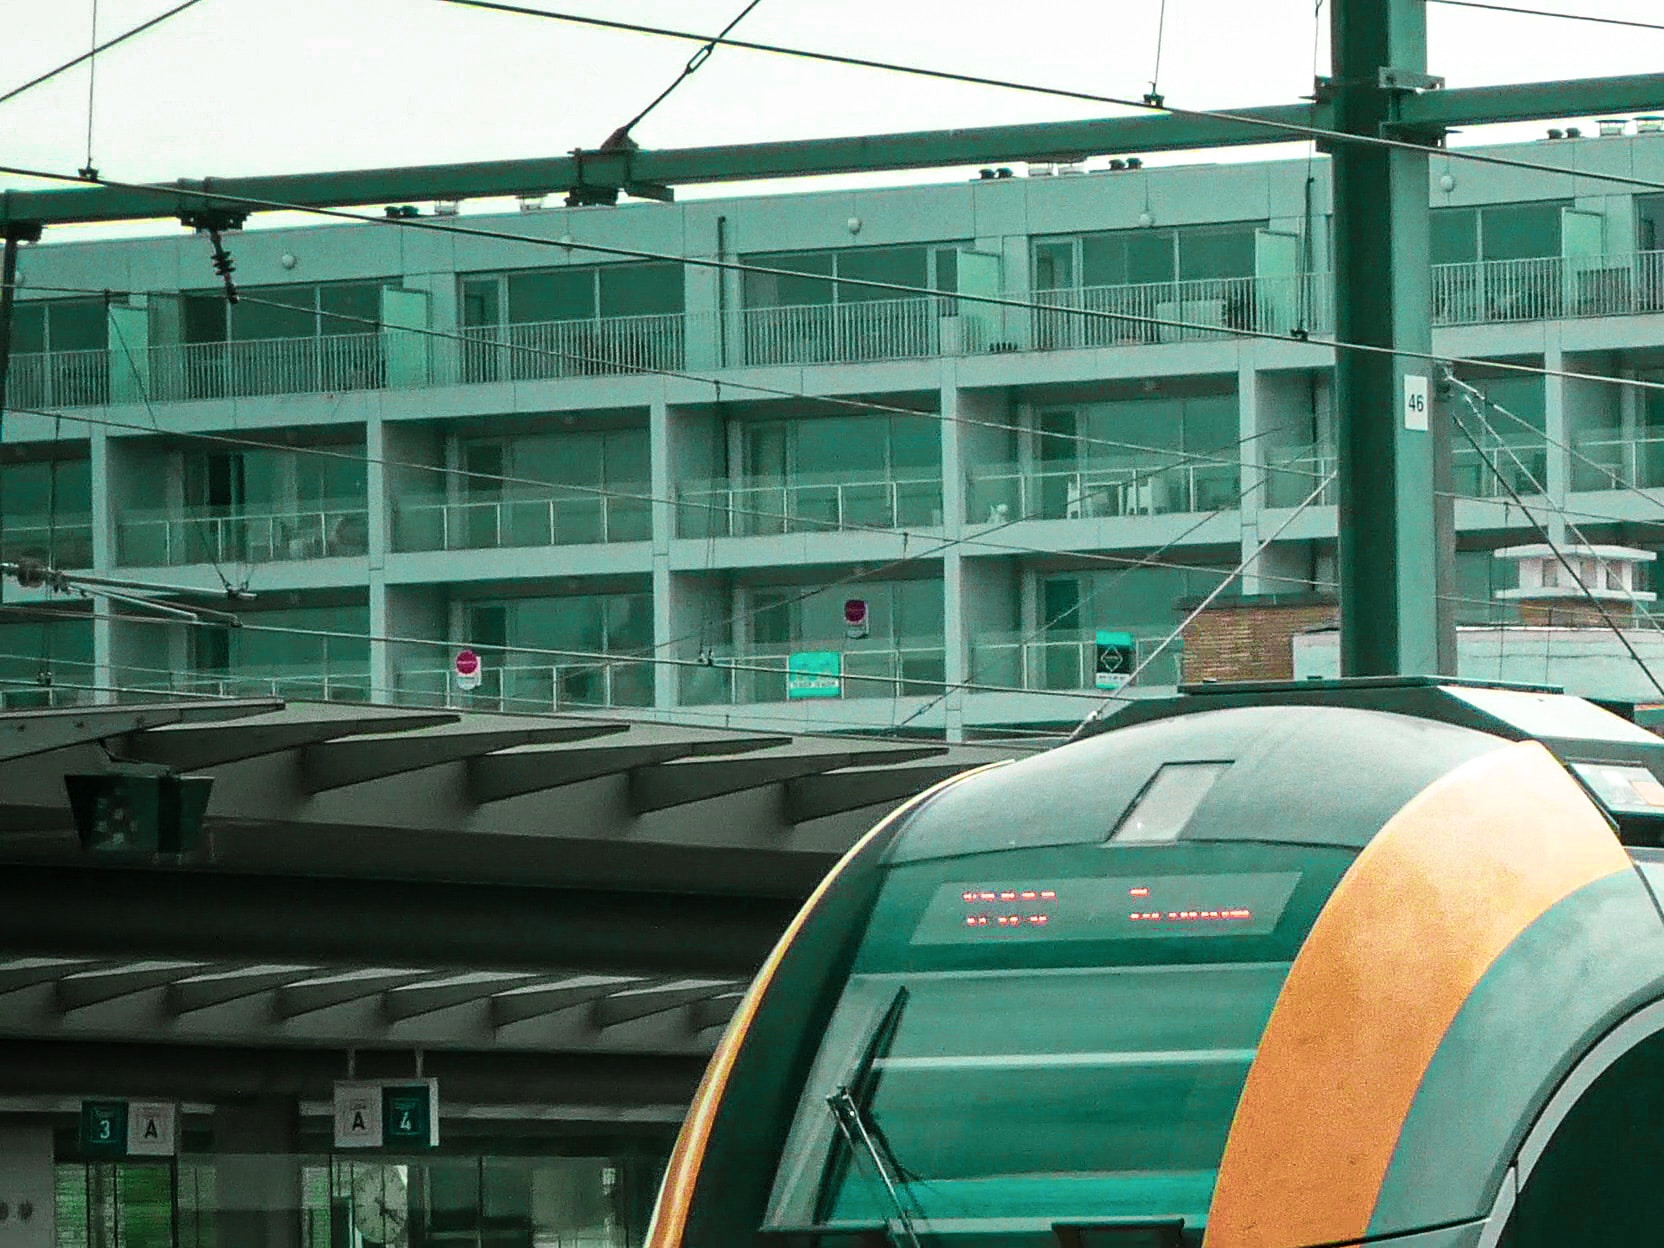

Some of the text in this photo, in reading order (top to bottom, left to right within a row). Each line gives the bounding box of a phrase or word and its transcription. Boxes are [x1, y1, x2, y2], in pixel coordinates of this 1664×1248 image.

[1408, 394, 1424, 412] 46
[100, 1118, 157, 1139] 3 A
[352, 1110, 411, 1131] A 4
